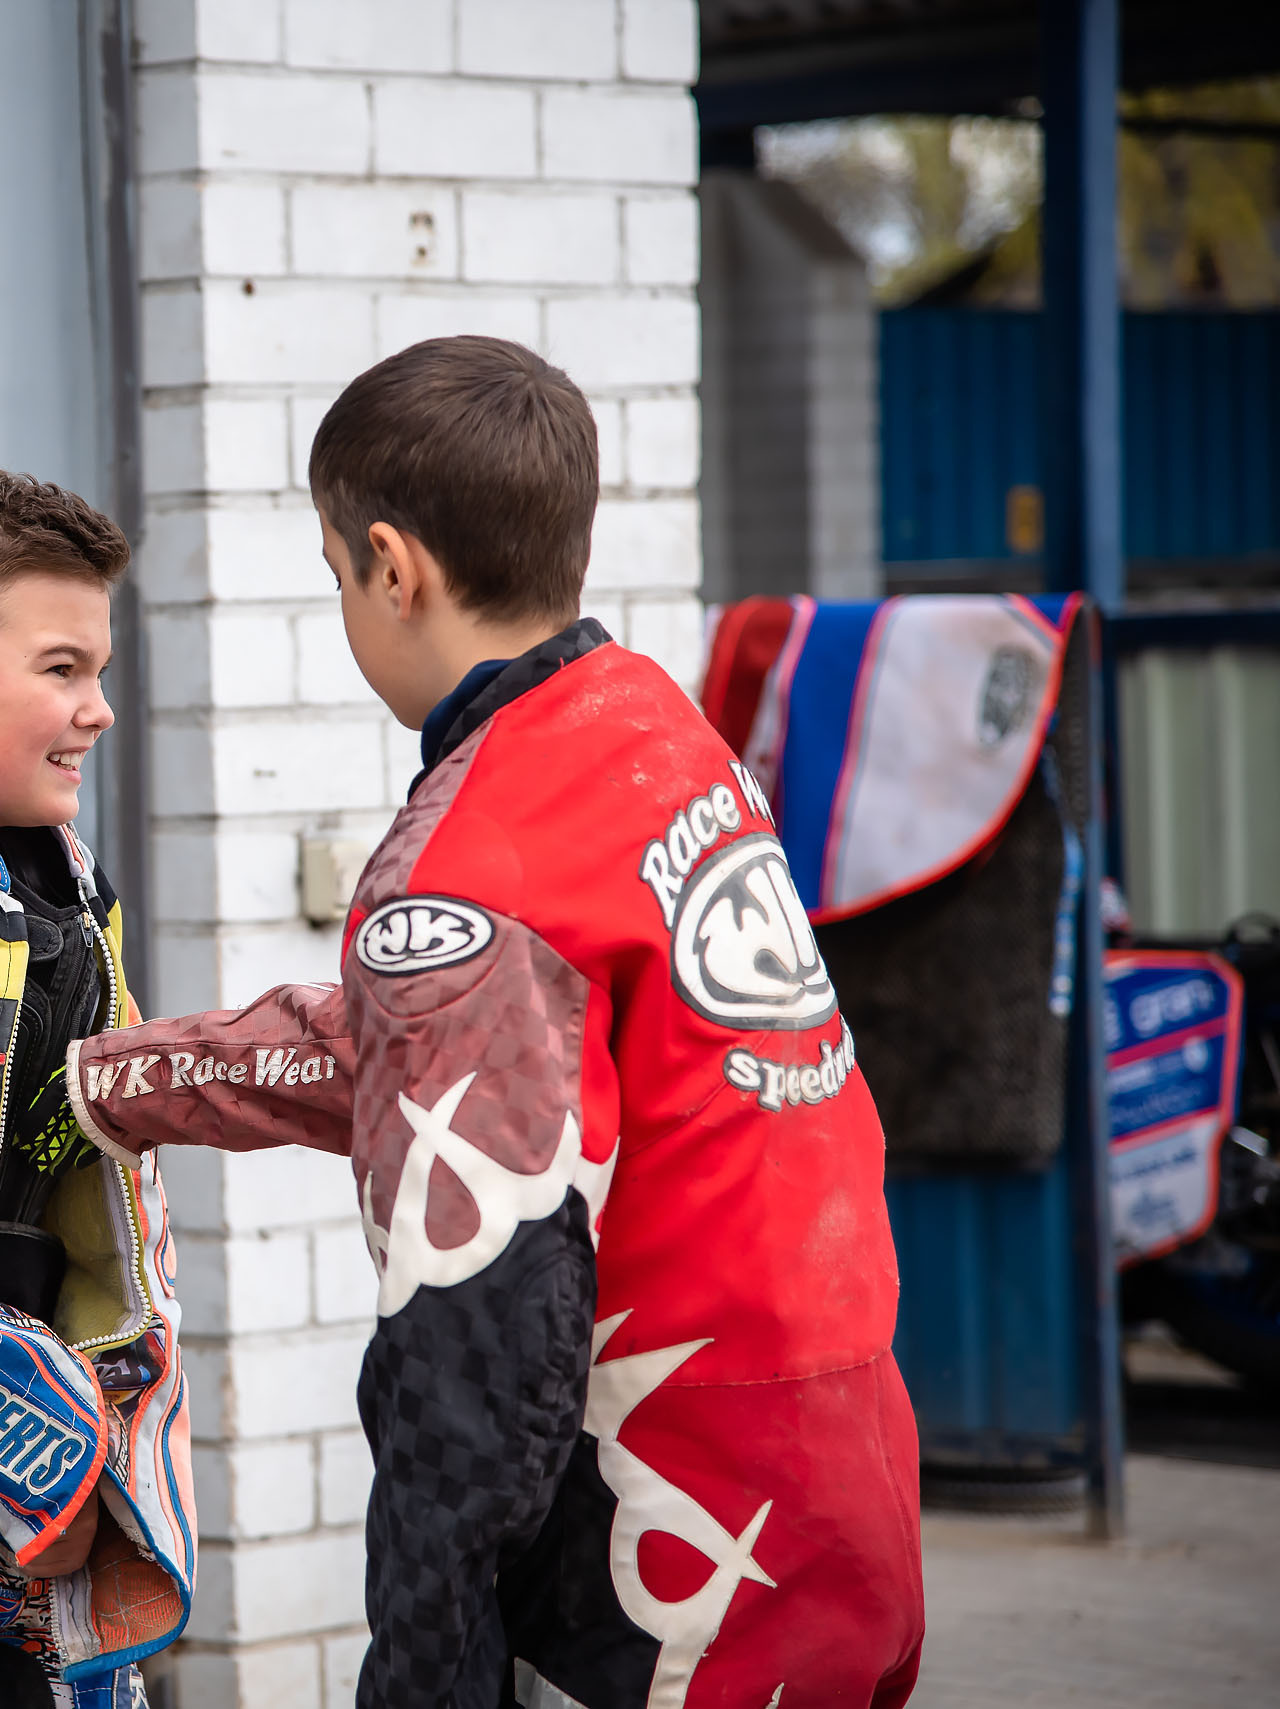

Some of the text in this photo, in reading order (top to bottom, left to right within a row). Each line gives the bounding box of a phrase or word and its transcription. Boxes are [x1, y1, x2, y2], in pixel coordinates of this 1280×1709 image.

[638, 782, 741, 932] Race
[86, 1047, 336, 1102] WK Race Wear
